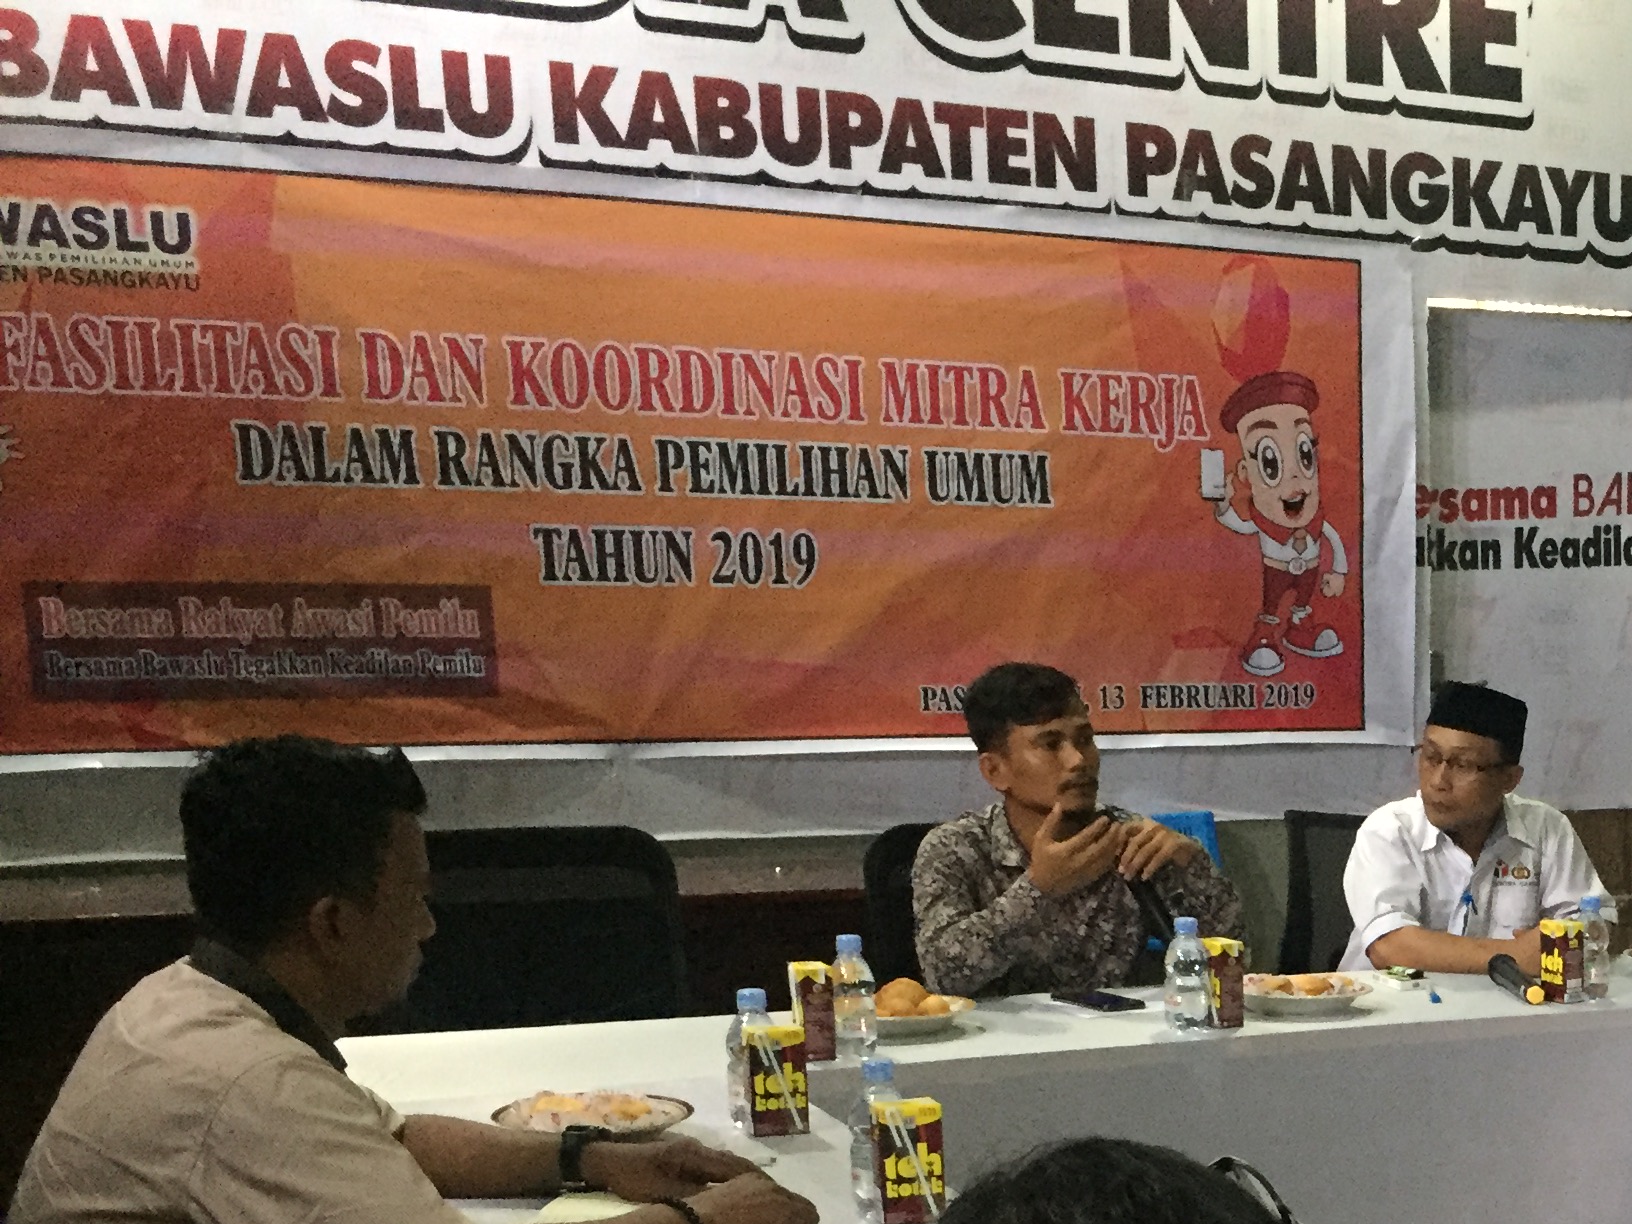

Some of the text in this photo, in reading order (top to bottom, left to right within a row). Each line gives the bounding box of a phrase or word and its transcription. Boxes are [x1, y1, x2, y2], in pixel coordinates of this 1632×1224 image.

[0, 8, 514, 139] BAWASLU
[549, 60, 1095, 194] KABUPATEN
[37, 266, 200, 293] PASANGKAYU
[0, 313, 1210, 451] FASILITASI DAN KOORDINASI MITRA KERJA
[232, 420, 1054, 507] DALAM RANGKA PEMILIHAN UMUM
[1416, 483, 1557, 524] ersama
[530, 524, 819, 589] TAHUN 2019
[38, 596, 481, 645] Bersama Rakyat Awasi Pemilu
[46, 647, 486, 682] Bersama Bawaslu Tegakkan Keadilan Pemilu
[1098, 681, 1317, 711] 13 FEBRUARI 2019
[754, 1062, 806, 1094] teh
[884, 1142, 942, 1180] teh
